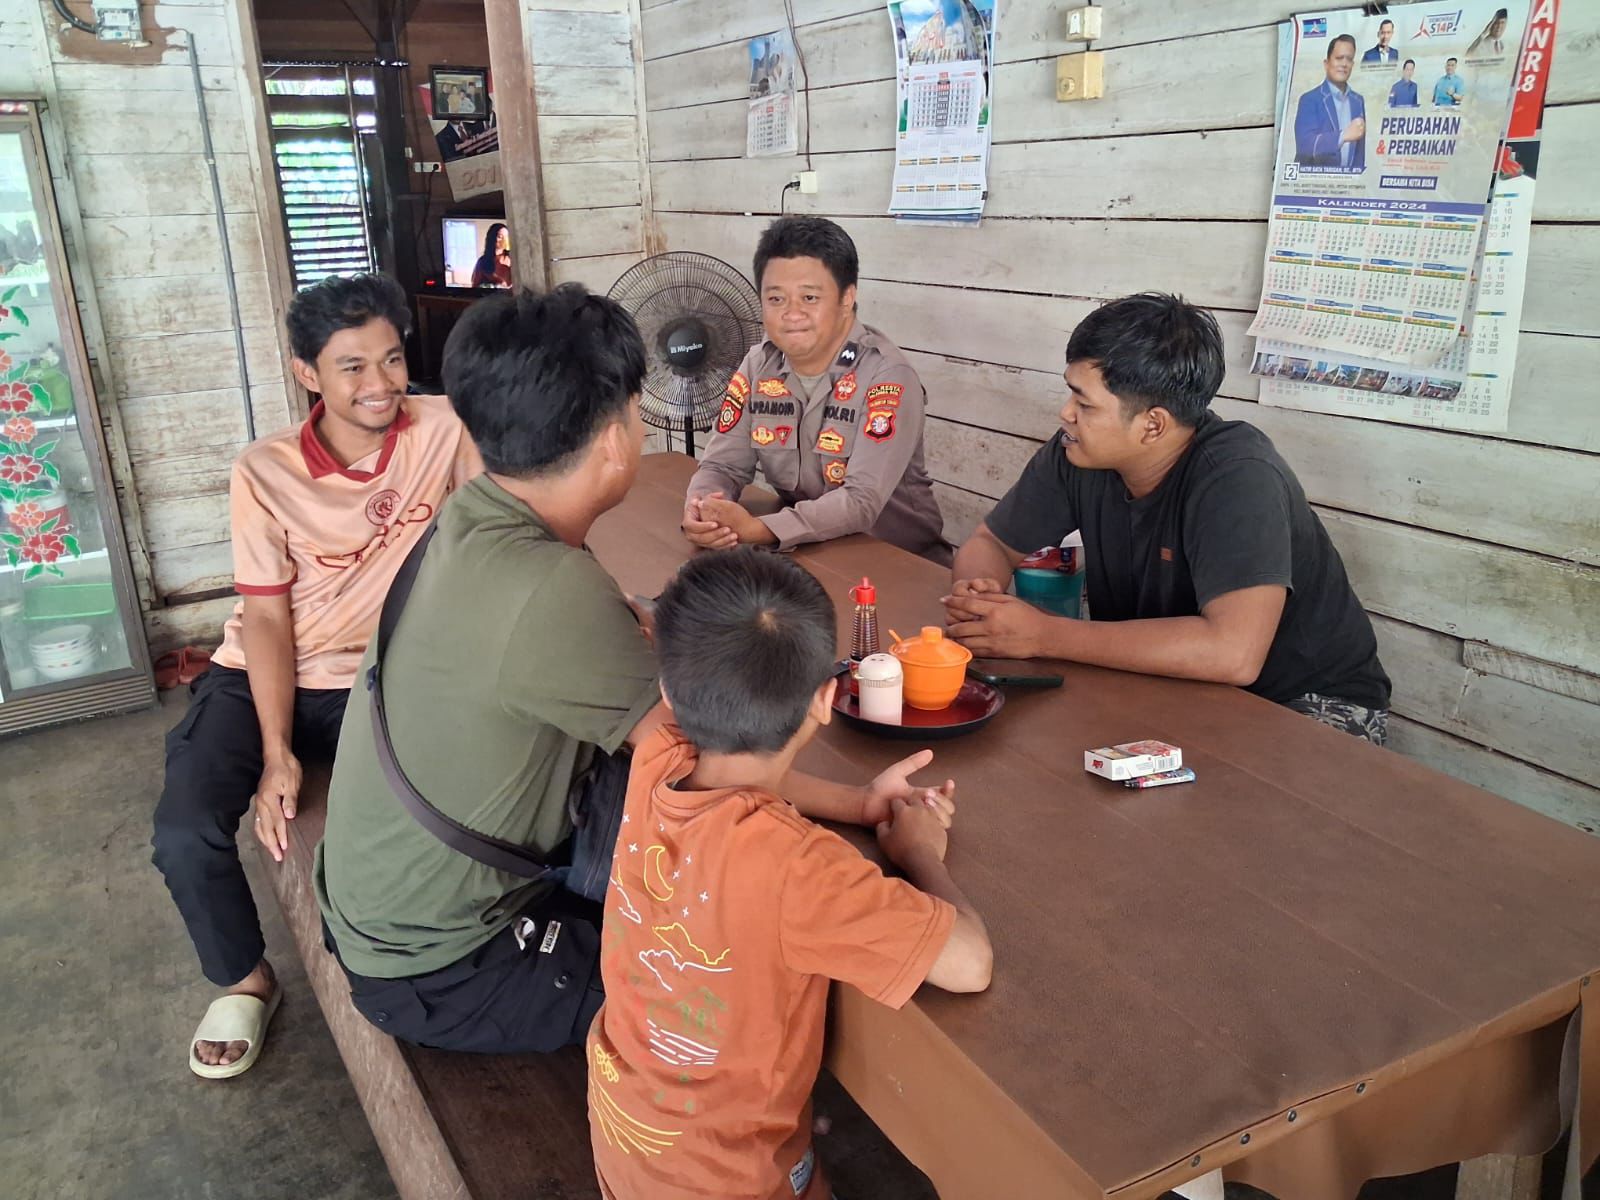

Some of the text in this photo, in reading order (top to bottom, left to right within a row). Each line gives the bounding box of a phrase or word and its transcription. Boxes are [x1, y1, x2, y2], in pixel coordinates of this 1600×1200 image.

[1380, 116, 1461, 135] PERUBAHAN
[1376, 139, 1456, 155] & PERBAIKAN
[1288, 167, 1295, 178] 2
[1317, 198, 1428, 210] KALENDER 2024
[677, 343, 703, 353] Miyako
[823, 405, 856, 424] POLRI
